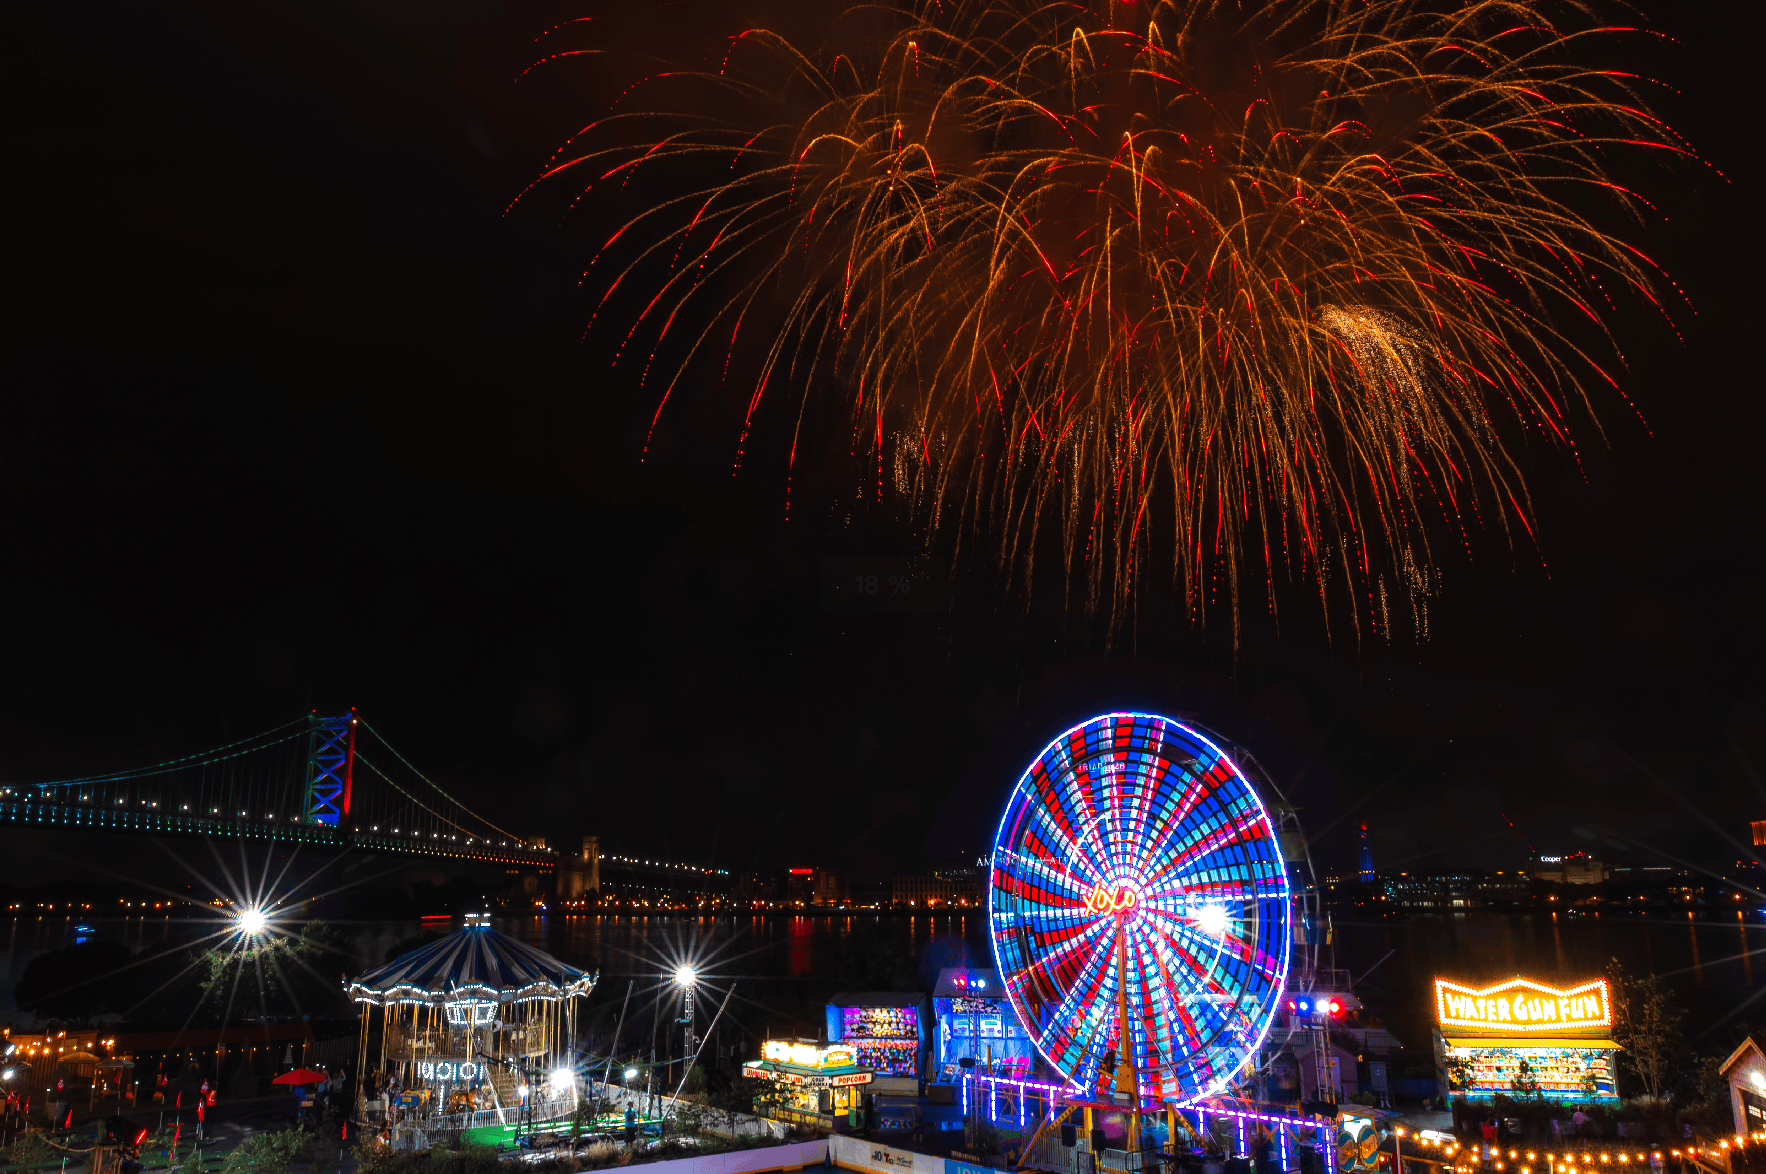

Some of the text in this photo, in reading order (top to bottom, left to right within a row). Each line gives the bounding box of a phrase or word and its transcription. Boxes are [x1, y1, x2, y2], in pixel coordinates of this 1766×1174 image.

[1540, 855, 1562, 863] Cooper
[1446, 993, 1600, 1021] WATER GUN FUN
[838, 1075, 867, 1084] POPCORN
